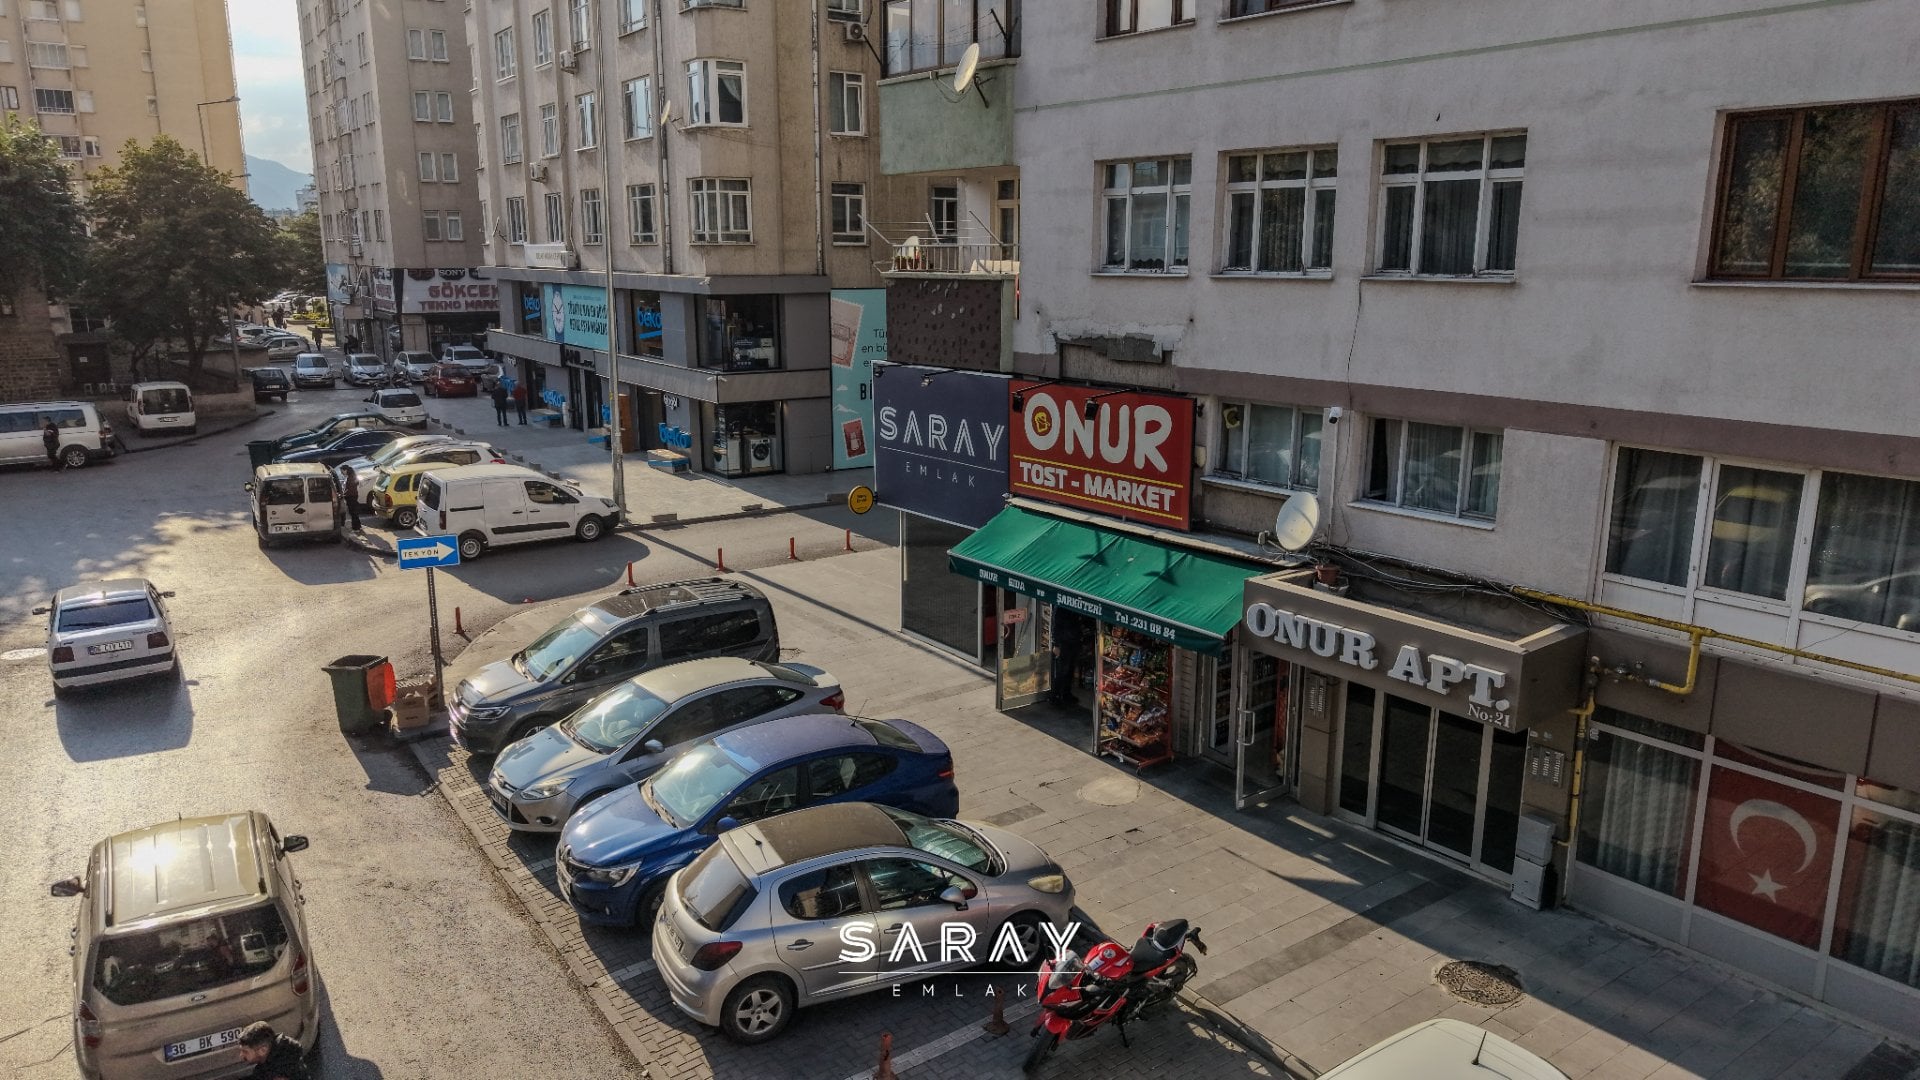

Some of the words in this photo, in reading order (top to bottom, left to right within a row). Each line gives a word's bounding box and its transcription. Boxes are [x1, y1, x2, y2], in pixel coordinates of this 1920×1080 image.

[439, 269, 465, 277] SONY
[419, 301, 461, 311] TEKNO
[637, 305, 663, 329] beko
[861, 345, 873, 353] en
[658, 422, 692, 449] beko
[879, 406, 1005, 462] SARAY
[1024, 392, 1172, 473] ONUR
[905, 461, 976, 488] EMLAK
[1019, 461, 1068, 491] TOST
[1084, 473, 1176, 512] MARKET
[1246, 602, 1378, 670] ONUR
[1387, 645, 1510, 711] APT.
[1467, 703, 1510, 728] No:21
[172, 1043, 186, 1056] 38
